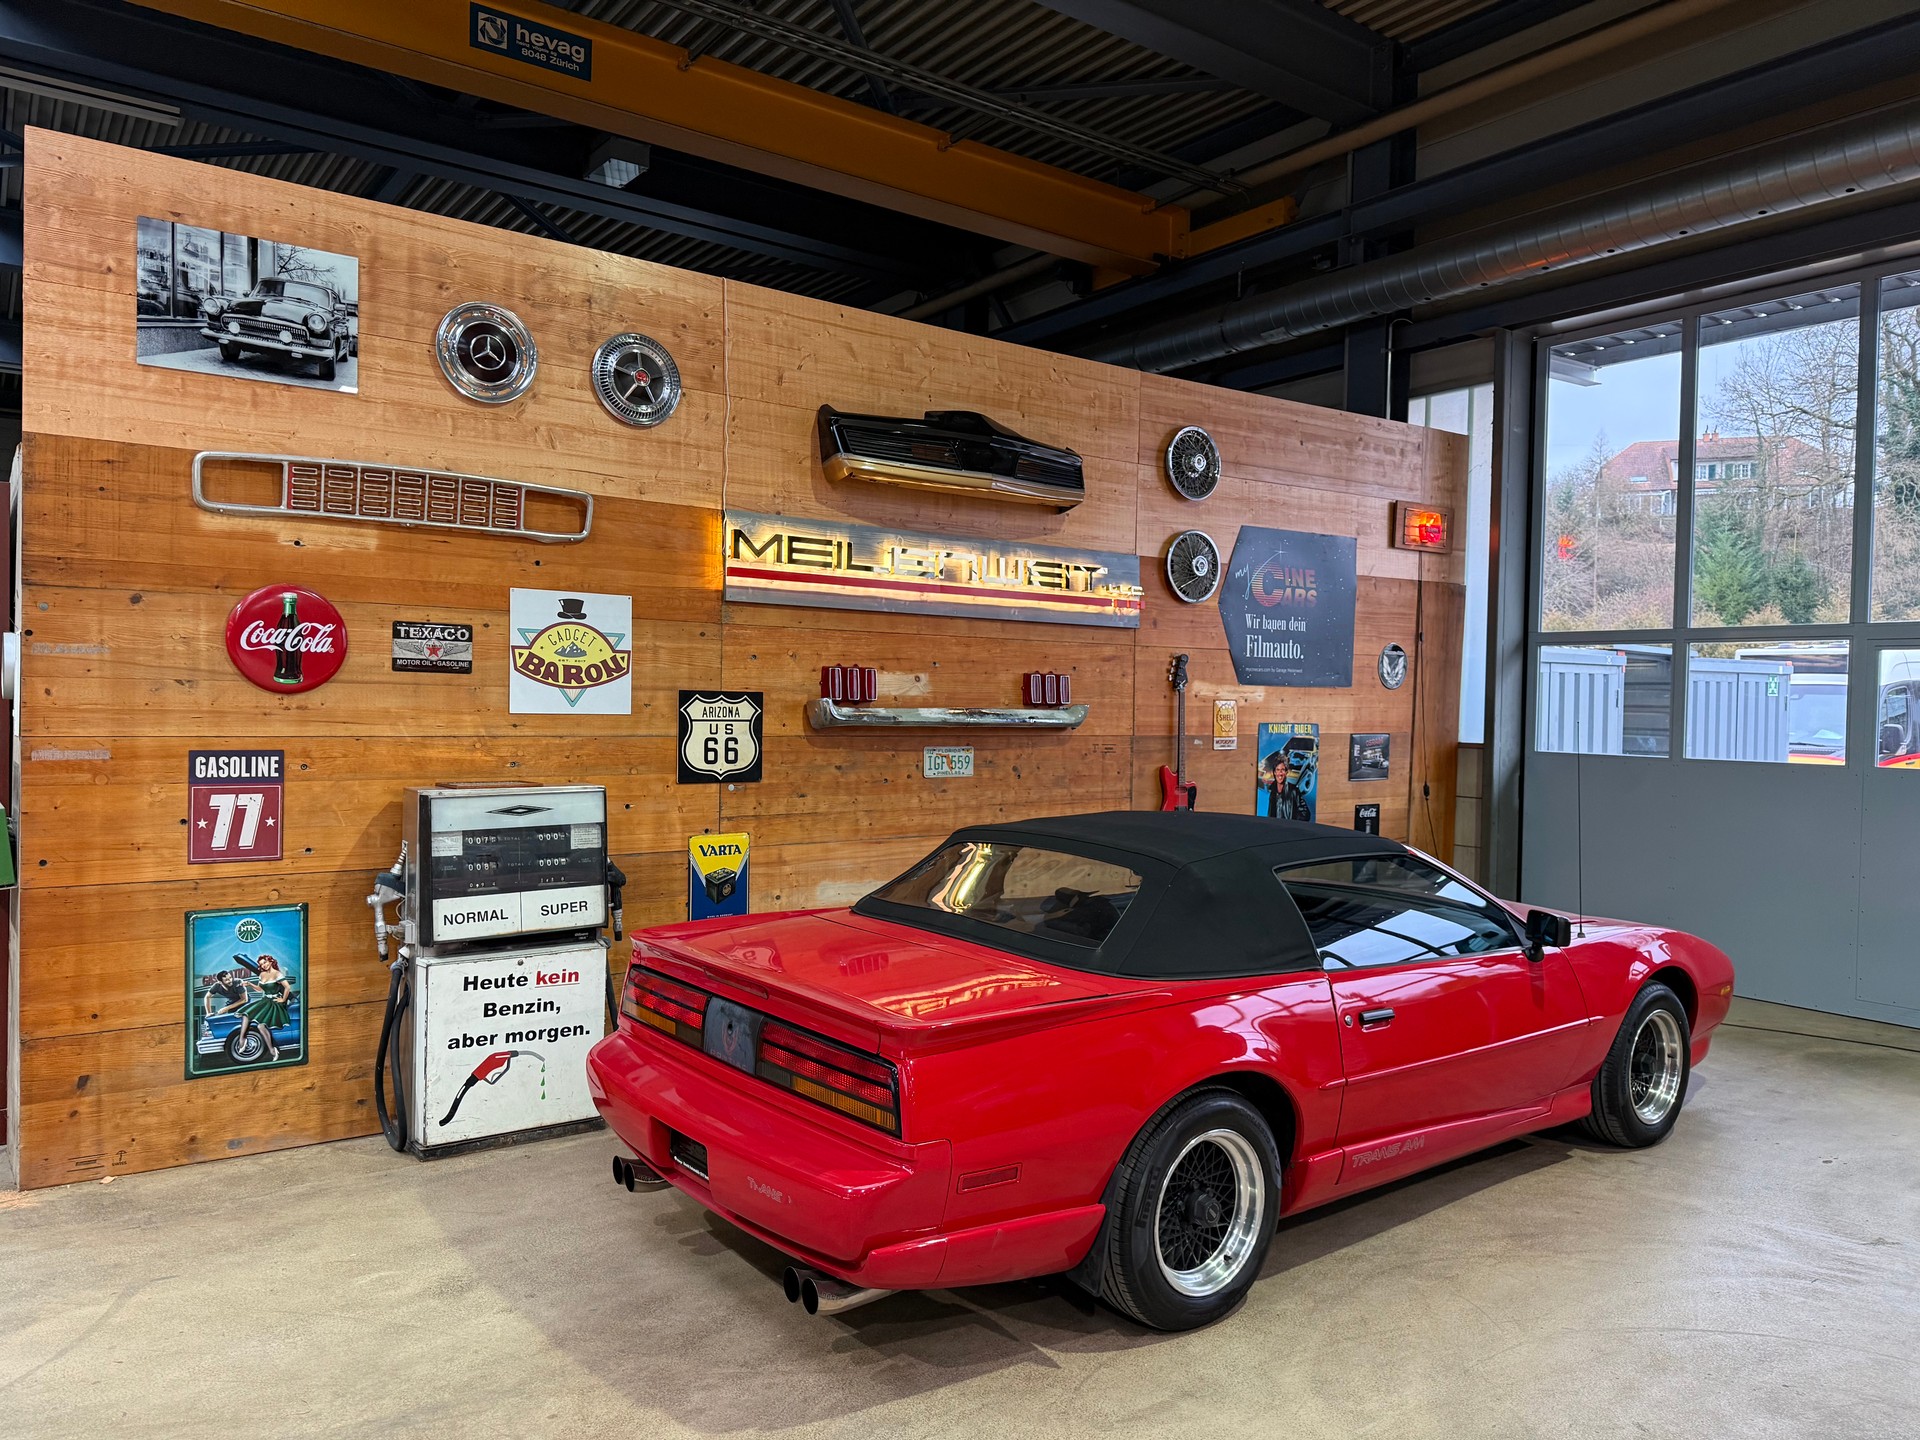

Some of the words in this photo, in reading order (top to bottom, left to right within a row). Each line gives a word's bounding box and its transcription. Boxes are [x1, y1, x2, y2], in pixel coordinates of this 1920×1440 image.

[515, 23, 585, 63] hevag
[521, 47, 547, 62] 8048
[549, 55, 580, 72] Zürich
[397, 626, 470, 641] TEXACO
[1245, 613, 1261, 629] Wir
[1262, 614, 1287, 631] bauen
[1288, 616, 1306, 632] dein
[240, 620, 337, 653] Coca-Cola
[547, 627, 598, 648] GADGET
[1245, 634, 1304, 660] Filmauto.
[396, 658, 421, 666] MOTOR
[436, 660, 470, 668] GASOLINE
[519, 650, 626, 685] BARON
[701, 706, 741, 719] ARIZONA
[1219, 713, 1234, 721] SHELL
[1268, 723, 1292, 734] KNIGHT
[1293, 724, 1313, 734] RIDER
[703, 737, 739, 765] 66
[195, 756, 279, 778] GASOLINE
[209, 793, 265, 850] 77
[698, 843, 742, 857] VARTA
[443, 908, 509, 926] NORMAL
[540, 900, 588, 917] SUPER
[240, 924, 258, 932] NTK
[463, 972, 529, 992] Heute
[535, 968, 580, 987] kein
[483, 997, 561, 1019] Benzin,
[447, 1032, 498, 1050] aber
[505, 1023, 590, 1045] morgen.
[1352, 1142, 1401, 1168] TRANS
[1399, 1135, 1425, 1154] AM
